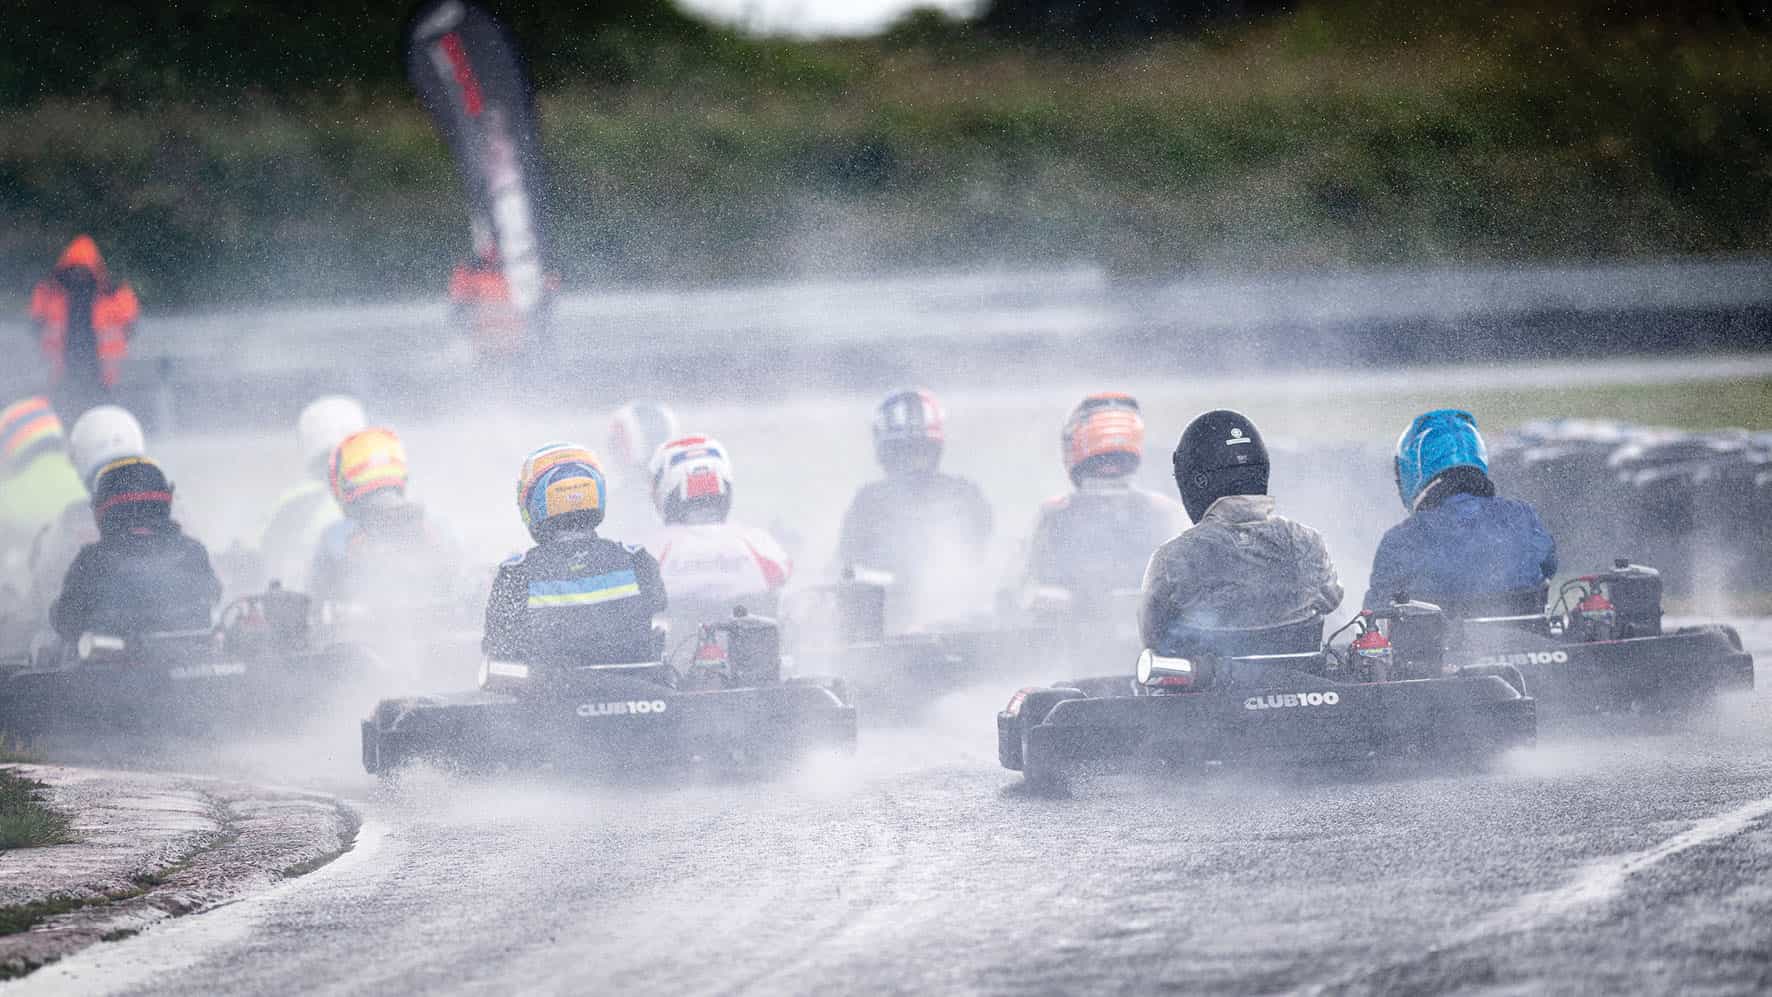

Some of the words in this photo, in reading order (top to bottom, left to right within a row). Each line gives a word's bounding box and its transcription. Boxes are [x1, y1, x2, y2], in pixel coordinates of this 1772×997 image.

[1475, 651, 1568, 667] UB100
[576, 700, 666, 716] CLUB100
[1243, 691, 1339, 710] CLUB100
